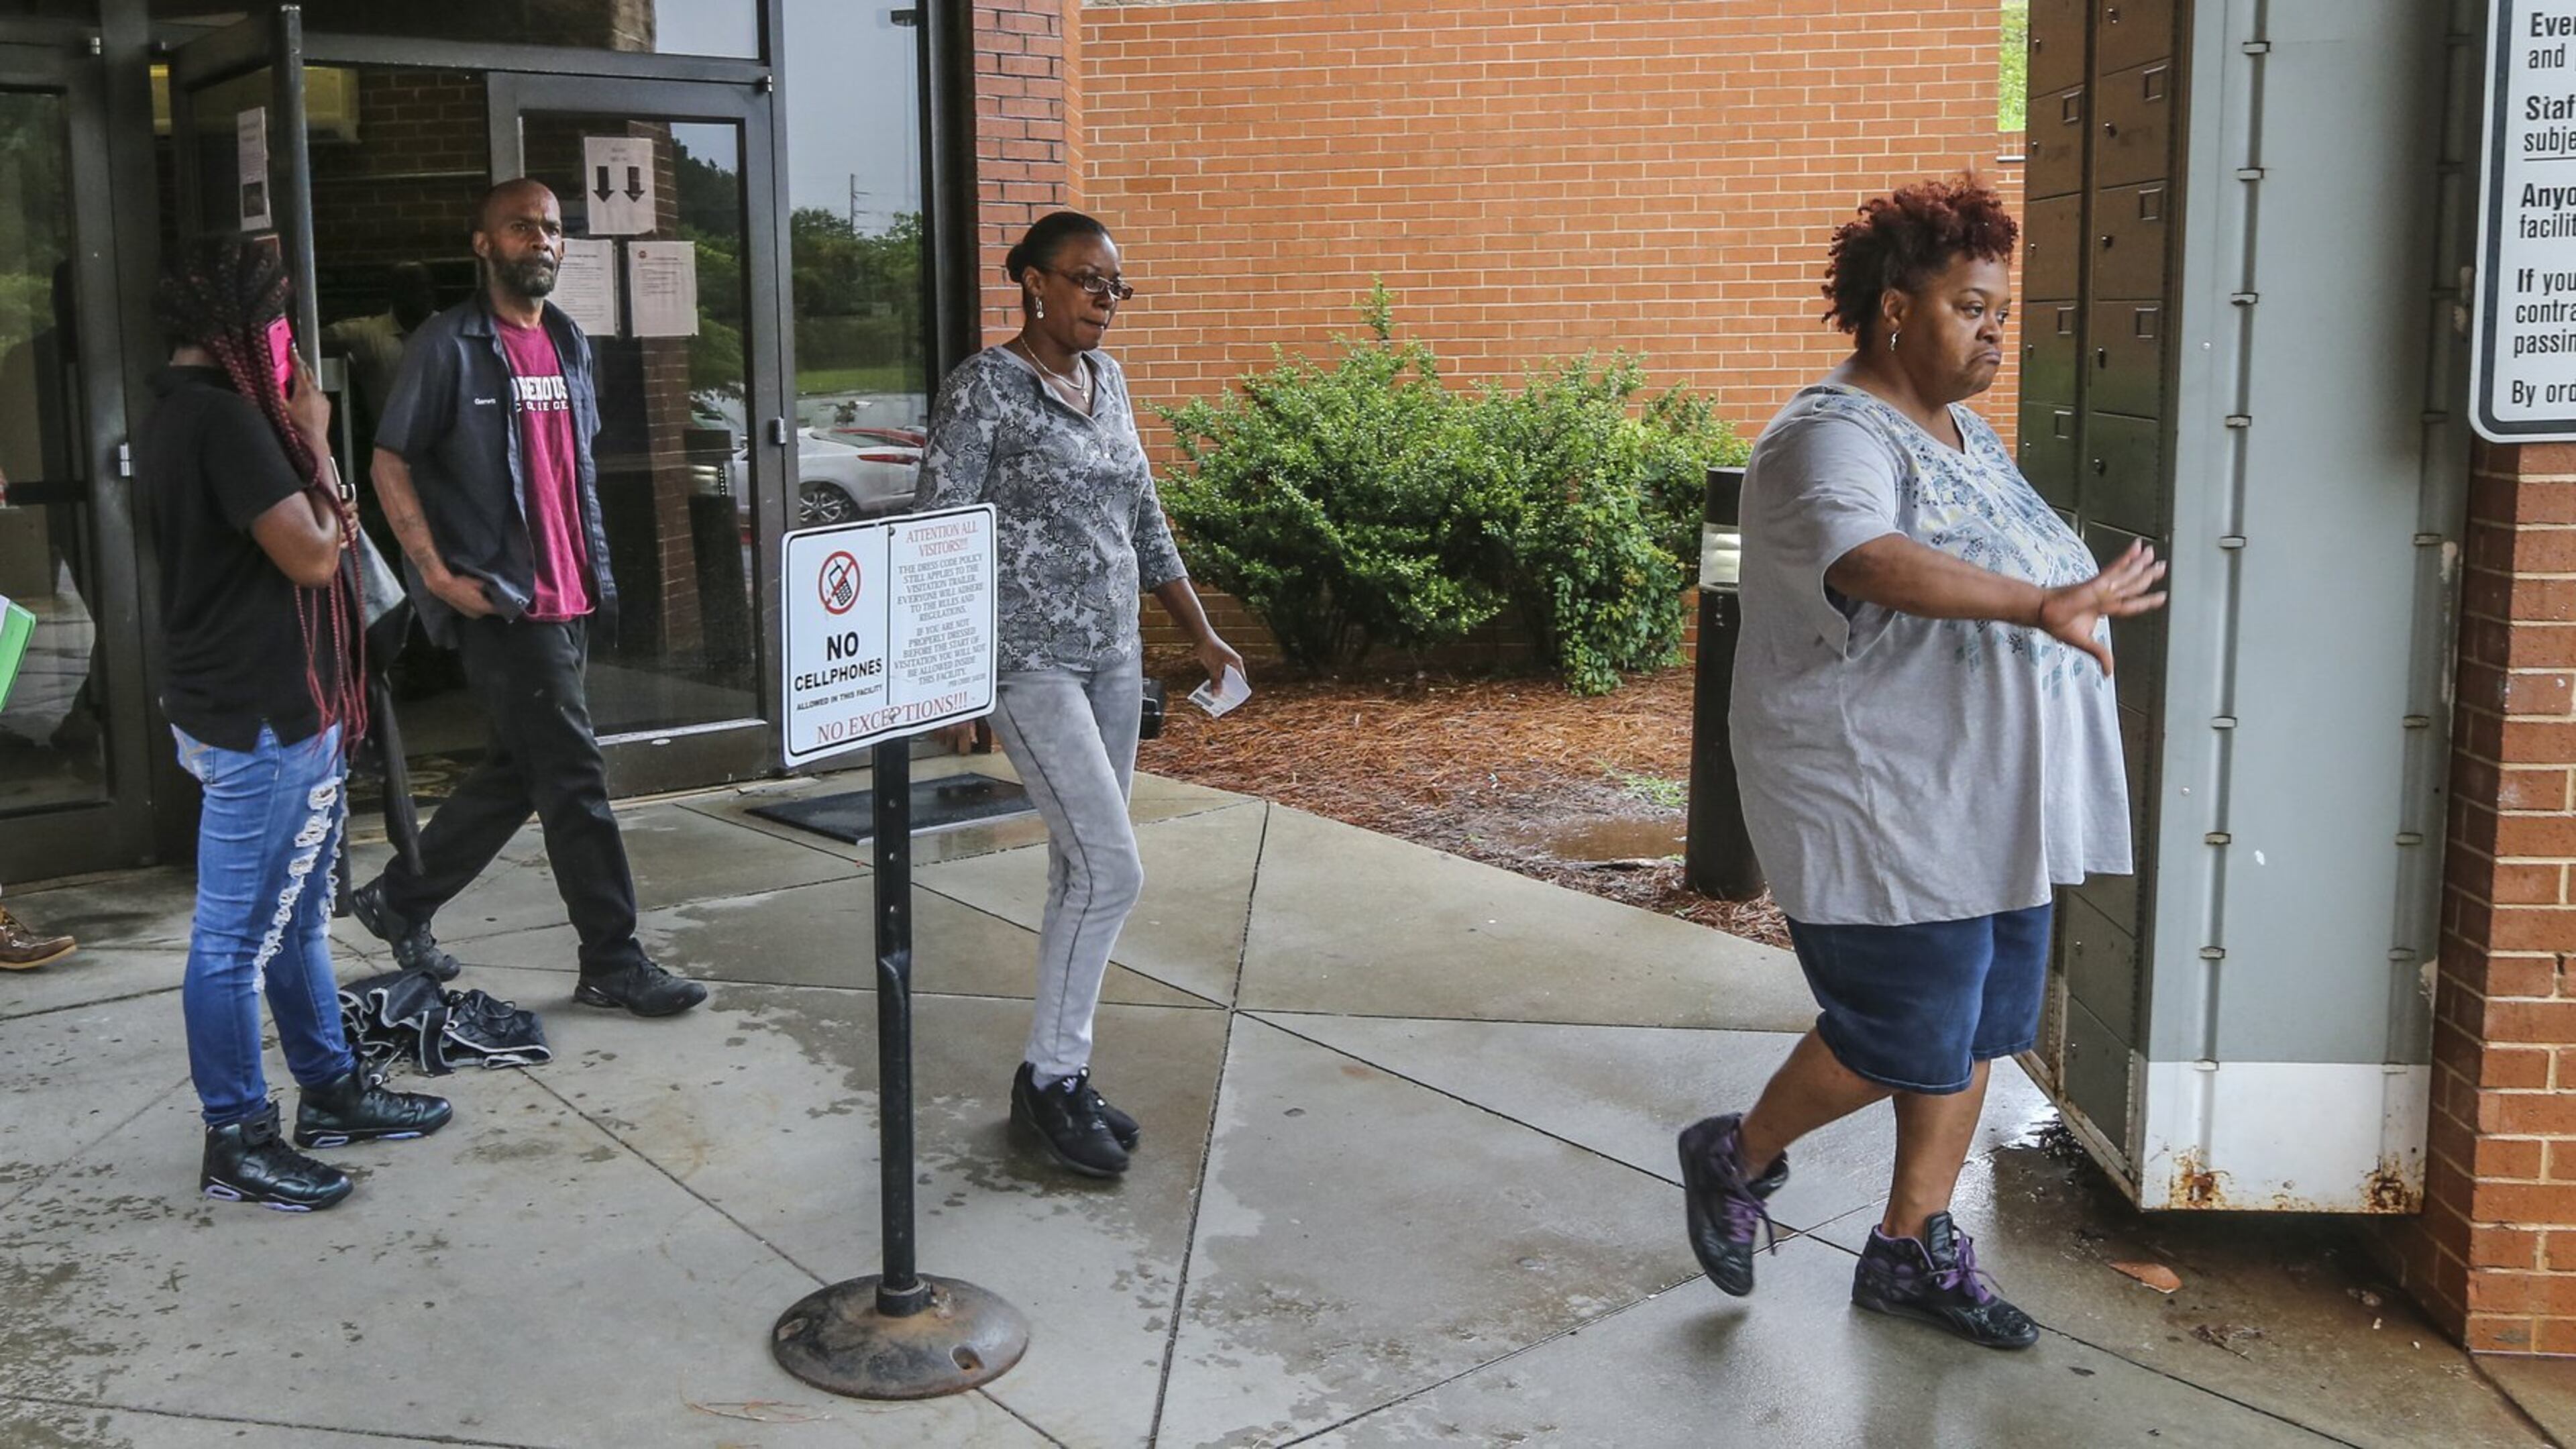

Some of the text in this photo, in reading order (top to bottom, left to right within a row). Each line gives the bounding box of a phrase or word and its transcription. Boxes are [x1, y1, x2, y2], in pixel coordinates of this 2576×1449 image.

[2528, 43, 2565, 68] and
[2526, 94, 2575, 120] Staf
[2524, 125, 2576, 155] subje
[2521, 183, 2576, 211] Anyo
[2517, 268, 2576, 296] If you
[2512, 380, 2536, 408] By
[906, 521, 978, 543] ATTENTION ALL
[898, 553, 982, 574] THE DRESS CODE POLICY
[903, 564, 979, 584] STILL APPLIES TO THE
[897, 582, 983, 604] EVERYONE WILL ADHERE
[906, 580, 947, 593] VISITATION
[910, 594, 975, 613] TO THE RULES AND
[908, 627, 976, 647] PROPERLY DRESSED
[916, 619, 969, 636] IF YOU ARE NOT
[827, 631, 859, 661] NO
[894, 643, 986, 669] VISITATION YOU WILL NOT
[903, 635, 979, 658] BEFORE THE START OF
[794, 658, 882, 692] CELLPHONES
[918, 676, 935, 685] THIS
[796, 698, 829, 710] ALLOWED
[840, 692, 855, 701] THIS
[857, 684, 882, 696] FACILITY
[817, 692, 967, 745] NO EXCEPTIONS!!!
